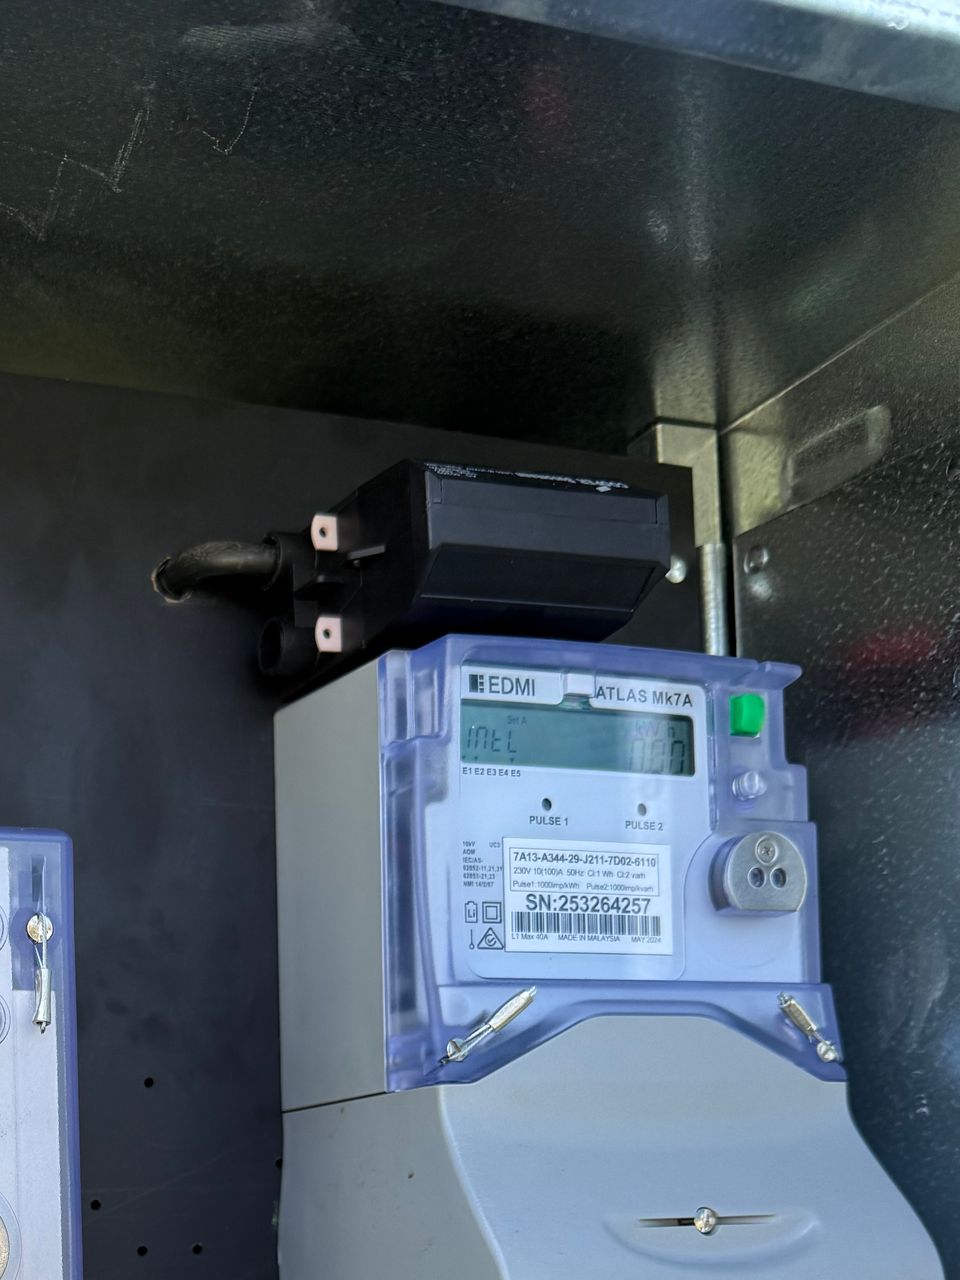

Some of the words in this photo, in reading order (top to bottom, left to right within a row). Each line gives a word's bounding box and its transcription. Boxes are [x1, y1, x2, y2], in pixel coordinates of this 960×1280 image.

[488, 675, 536, 697] EDMI
[596, 686, 647, 703] ATLAS
[652, 691, 693, 707] Mk7A
[529, 815, 561, 826] PULSE
[564, 817, 569, 826] 1
[625, 820, 656, 830] PULSE
[657, 823, 663, 831] 2
[525, 893, 651, 915] SN:253264257
